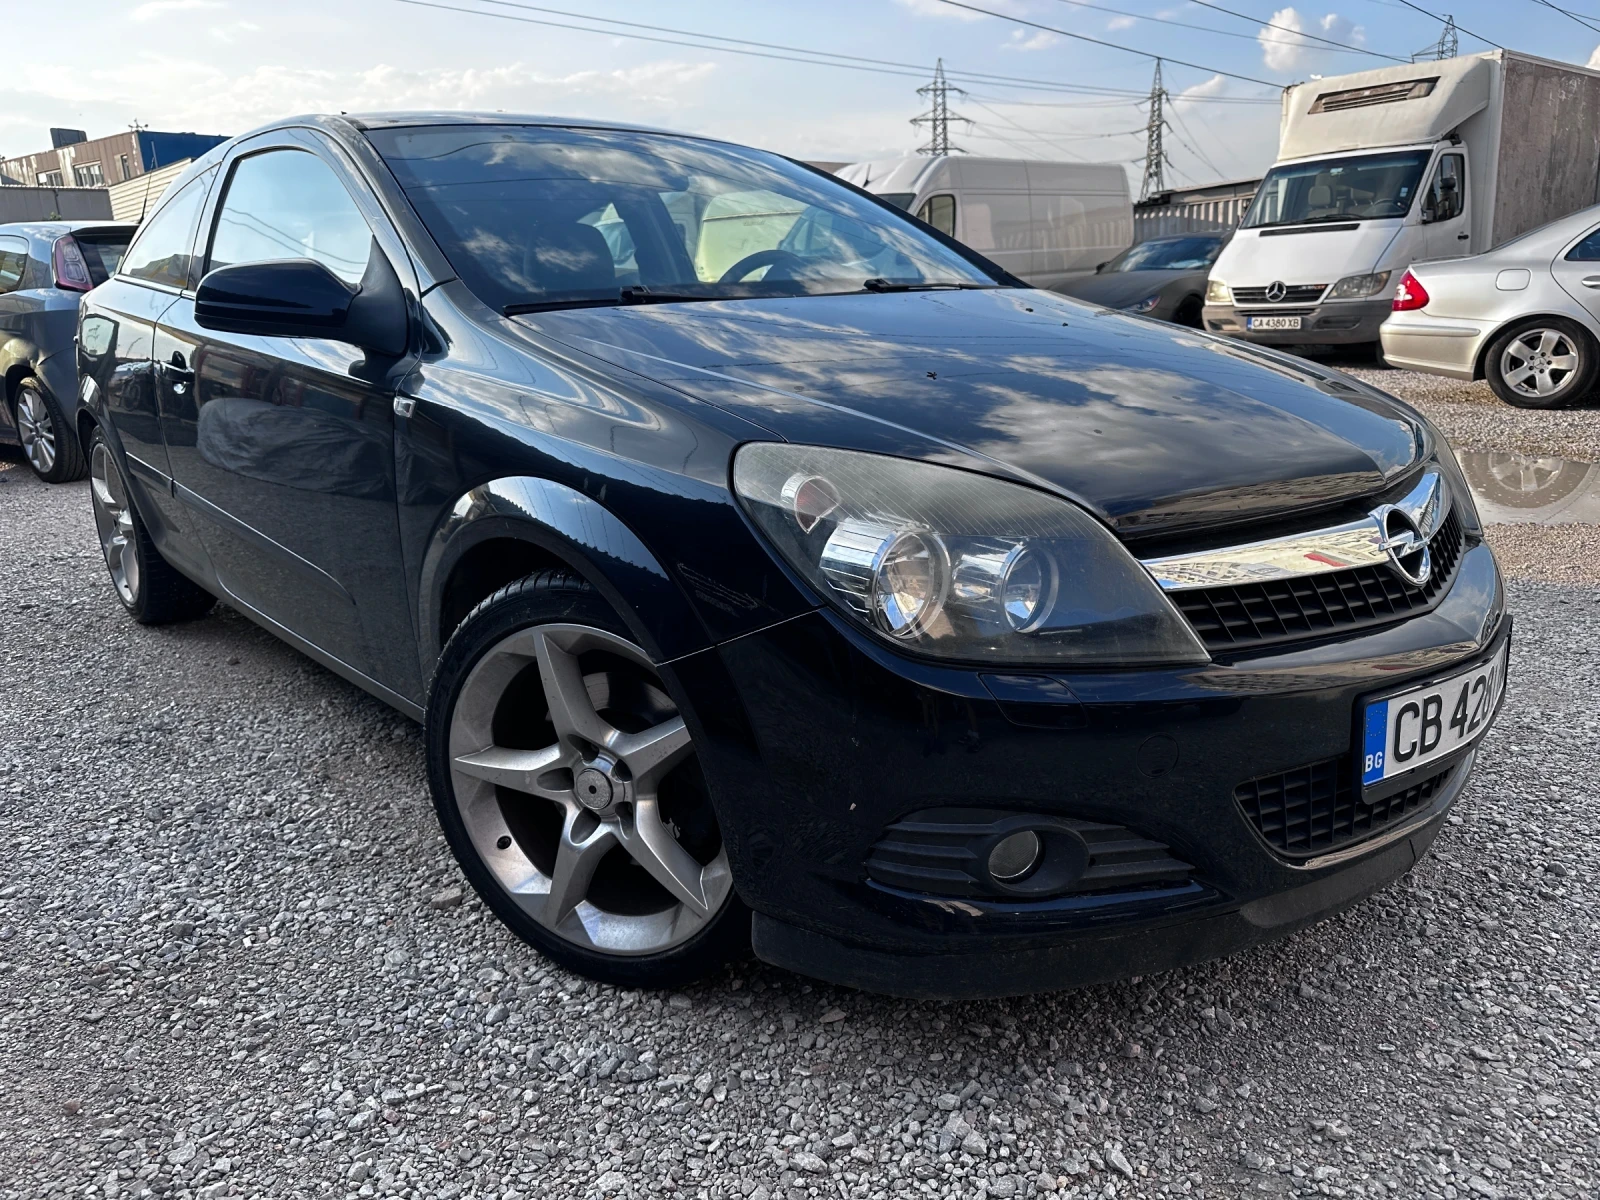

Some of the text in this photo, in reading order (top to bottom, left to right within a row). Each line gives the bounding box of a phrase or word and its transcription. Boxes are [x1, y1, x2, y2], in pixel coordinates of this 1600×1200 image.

[1253, 318, 1299, 328] CA 4380 XB
[1393, 692, 1443, 763] CB
[1364, 751, 1383, 773] BG
